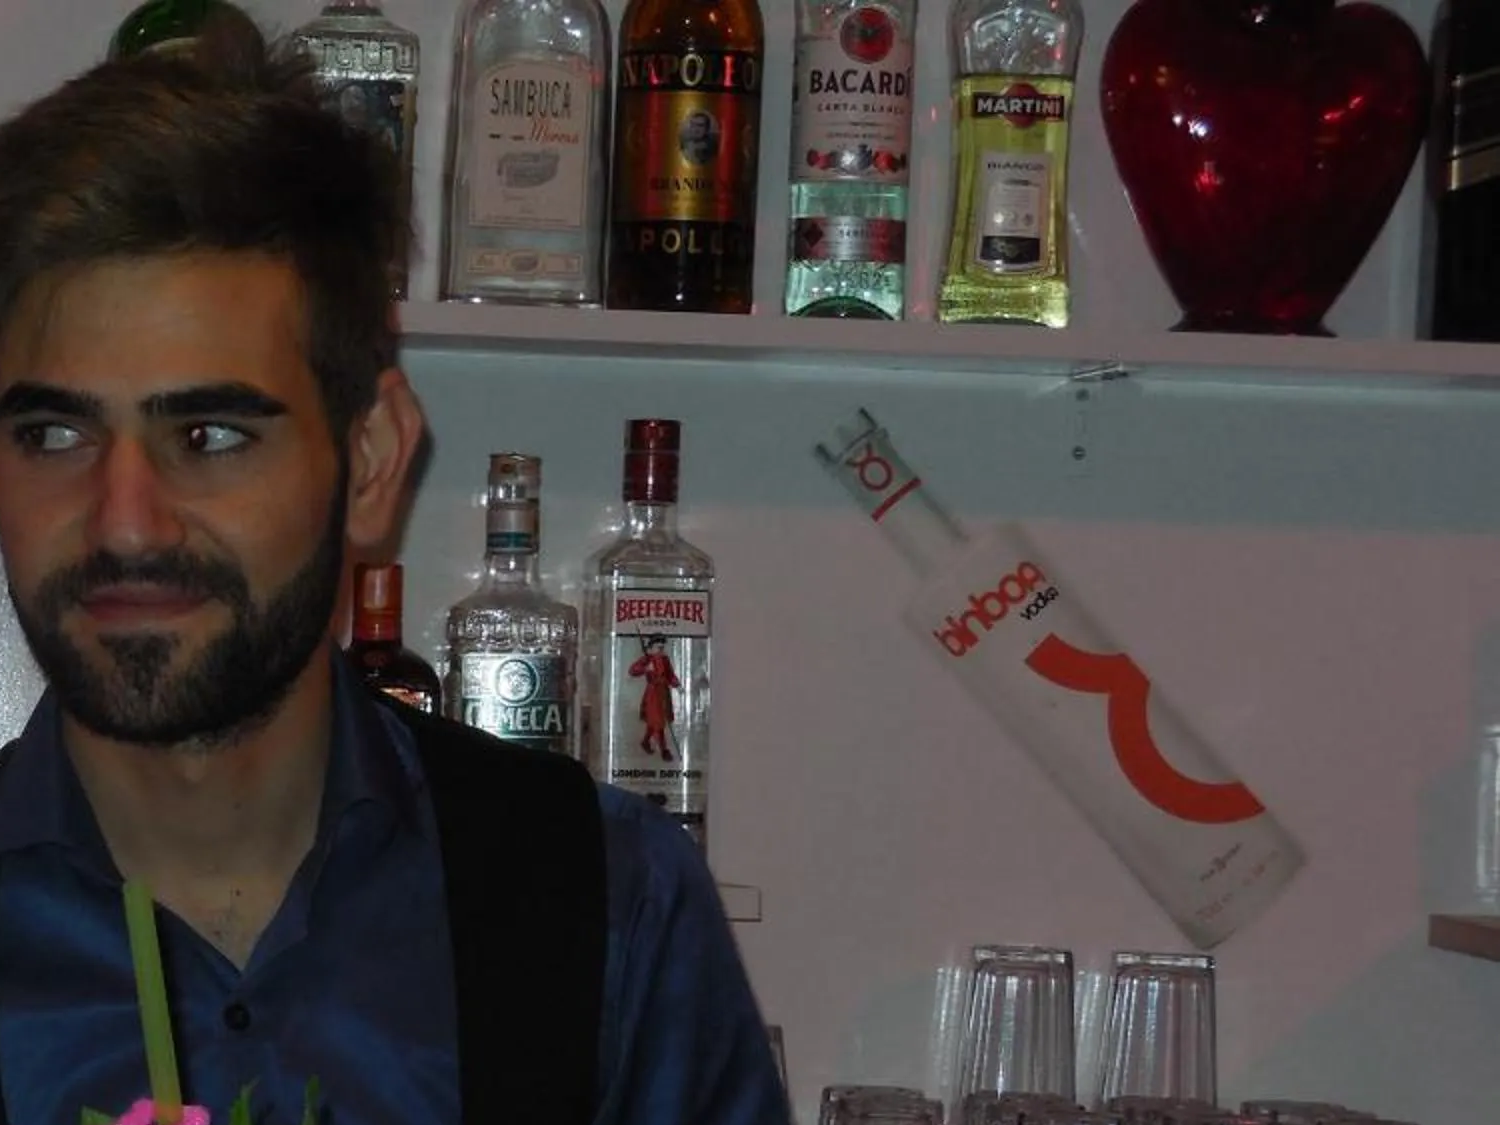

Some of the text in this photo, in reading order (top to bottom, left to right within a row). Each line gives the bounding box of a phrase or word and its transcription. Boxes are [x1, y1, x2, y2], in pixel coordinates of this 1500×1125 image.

[490, 78, 571, 119] SAMBUCA
[976, 96, 1062, 116] MARTINI
[616, 598, 705, 625] BEEFEATER
